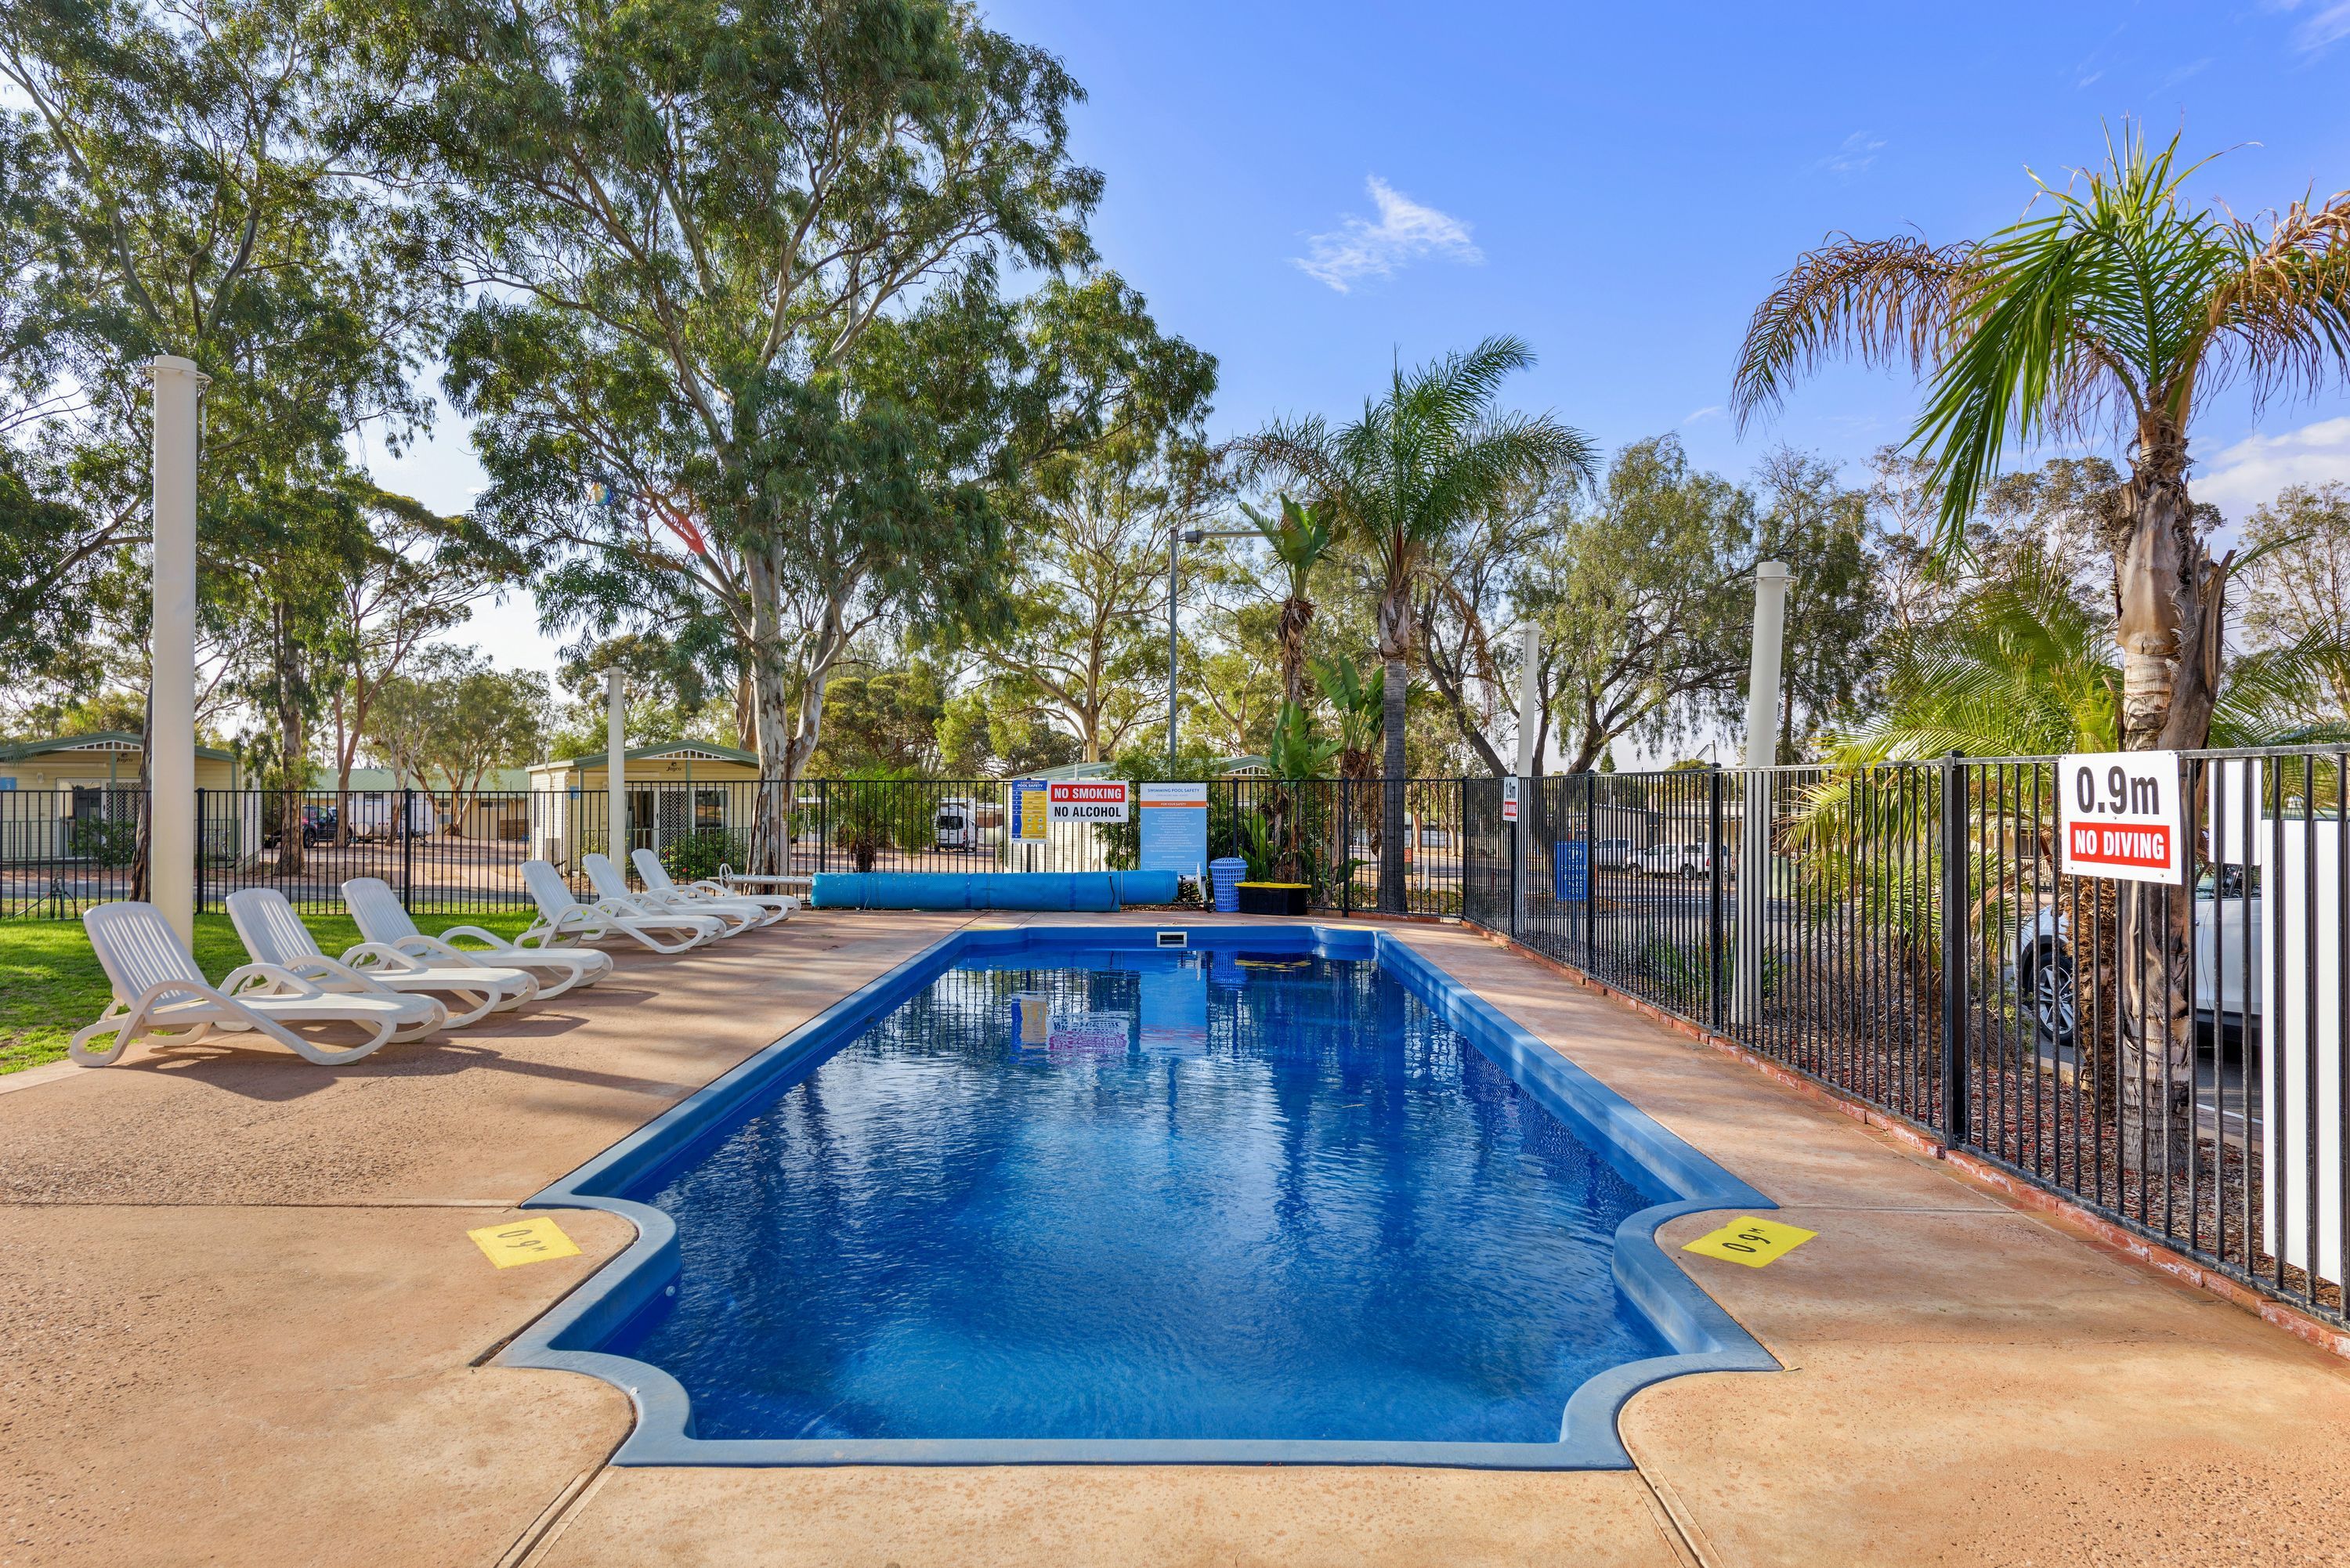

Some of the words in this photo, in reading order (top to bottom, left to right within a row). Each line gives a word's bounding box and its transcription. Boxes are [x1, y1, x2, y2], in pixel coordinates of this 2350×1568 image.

[1054, 787, 1069, 799] NO
[1072, 787, 1122, 799] SMOKING
[2077, 765, 2160, 815] 0.9m
[1054, 806, 1068, 817] NO
[1072, 806, 1122, 817] ALCOHOL
[2075, 829, 2097, 855] NO
[2103, 831, 2164, 860] DIVING
